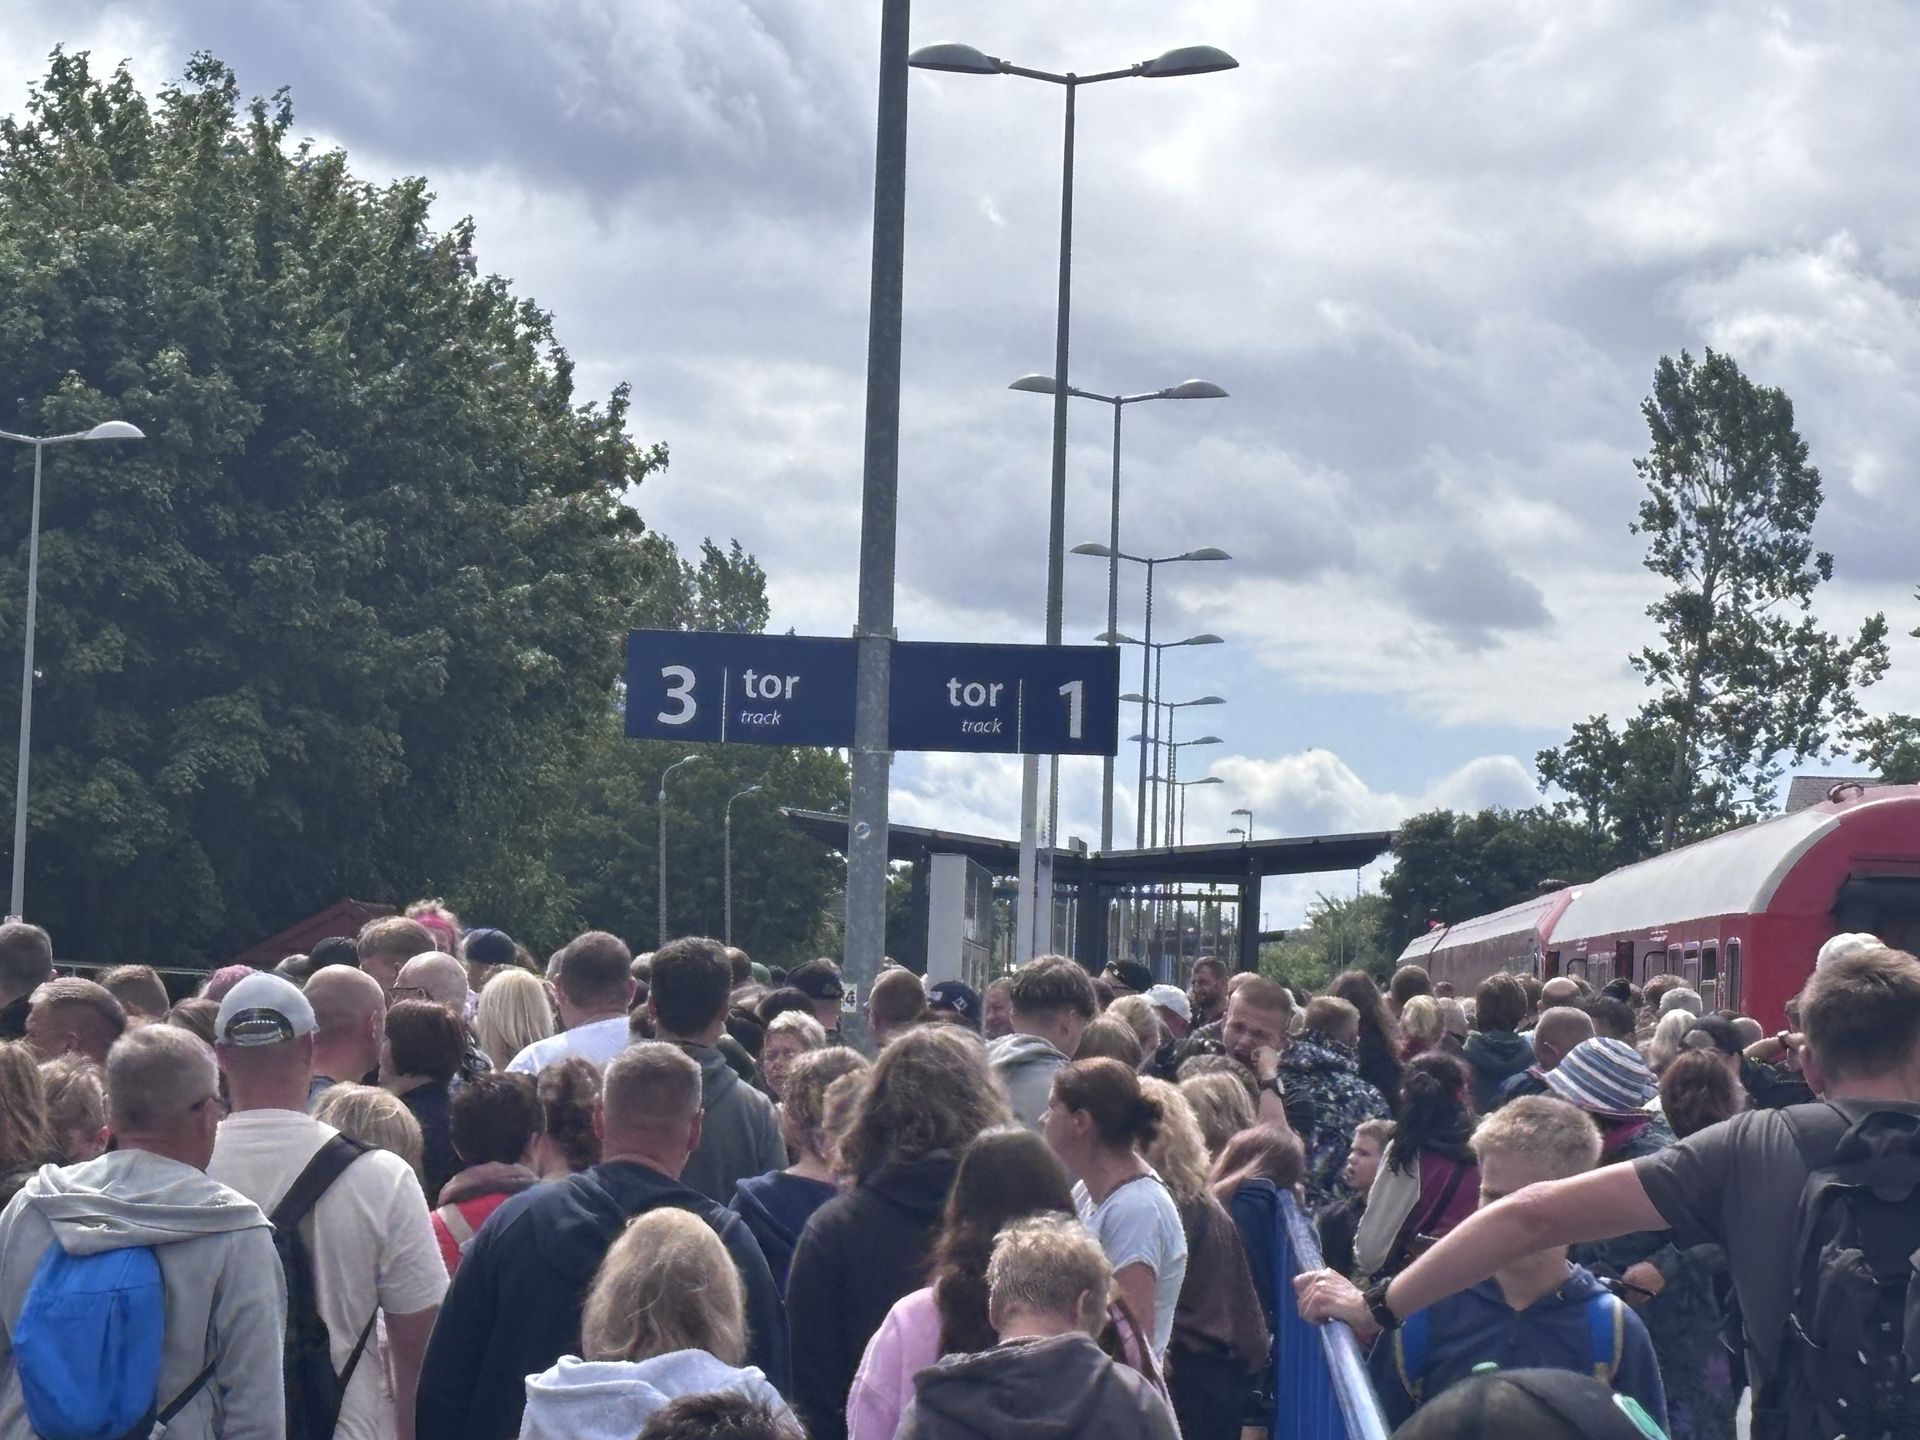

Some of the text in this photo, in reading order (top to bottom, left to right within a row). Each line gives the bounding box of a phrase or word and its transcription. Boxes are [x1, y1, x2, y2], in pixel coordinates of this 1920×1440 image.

[656, 665, 697, 725] 3
[742, 668, 801, 700] tor
[946, 677, 1004, 707] tor
[741, 710, 781, 726] track
[961, 717, 1003, 733] track
[1058, 680, 1083, 739] 1
